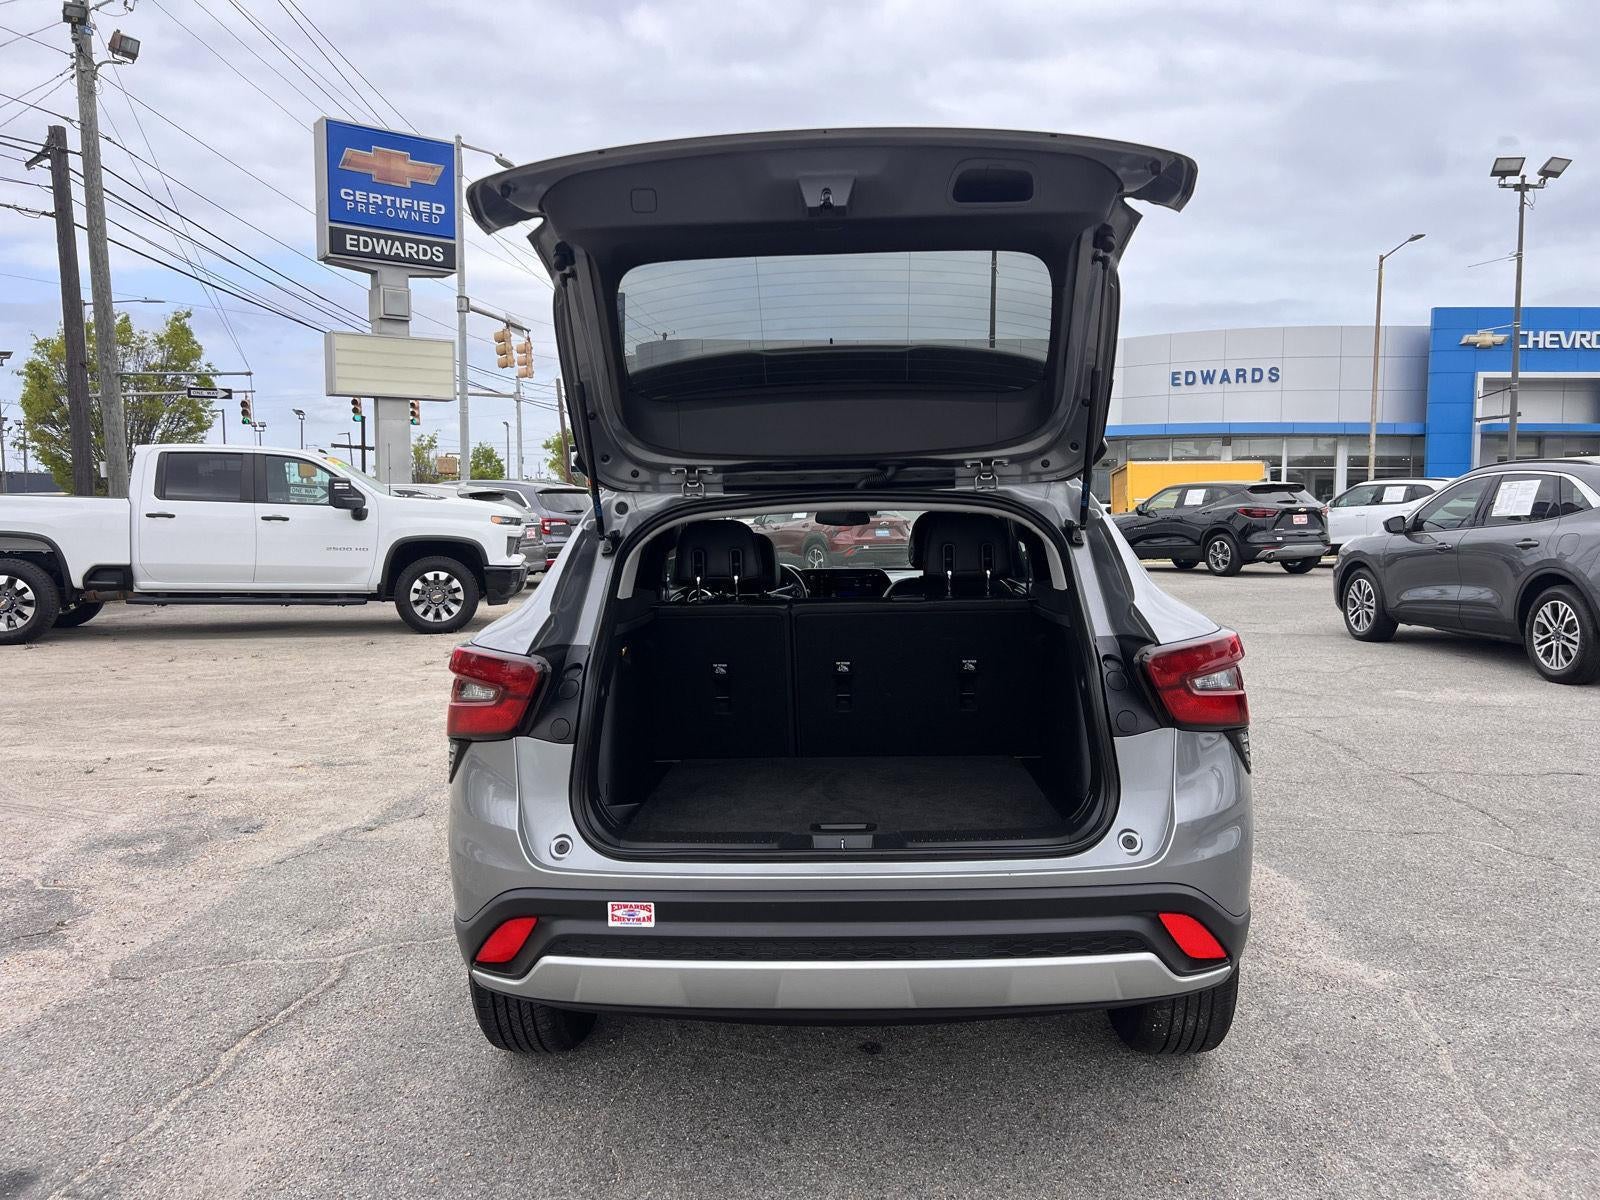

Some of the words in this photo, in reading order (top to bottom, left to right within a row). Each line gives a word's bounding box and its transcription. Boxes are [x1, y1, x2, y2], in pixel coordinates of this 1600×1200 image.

[340, 188, 446, 215] CERTIFIED
[346, 202, 441, 224] PRE-OWNED
[345, 234, 445, 262] EDWARDS
[1170, 366, 1281, 387] EDWARDS
[610, 903, 652, 913] EDWARDS
[610, 913, 653, 923] CHEVYMAN
